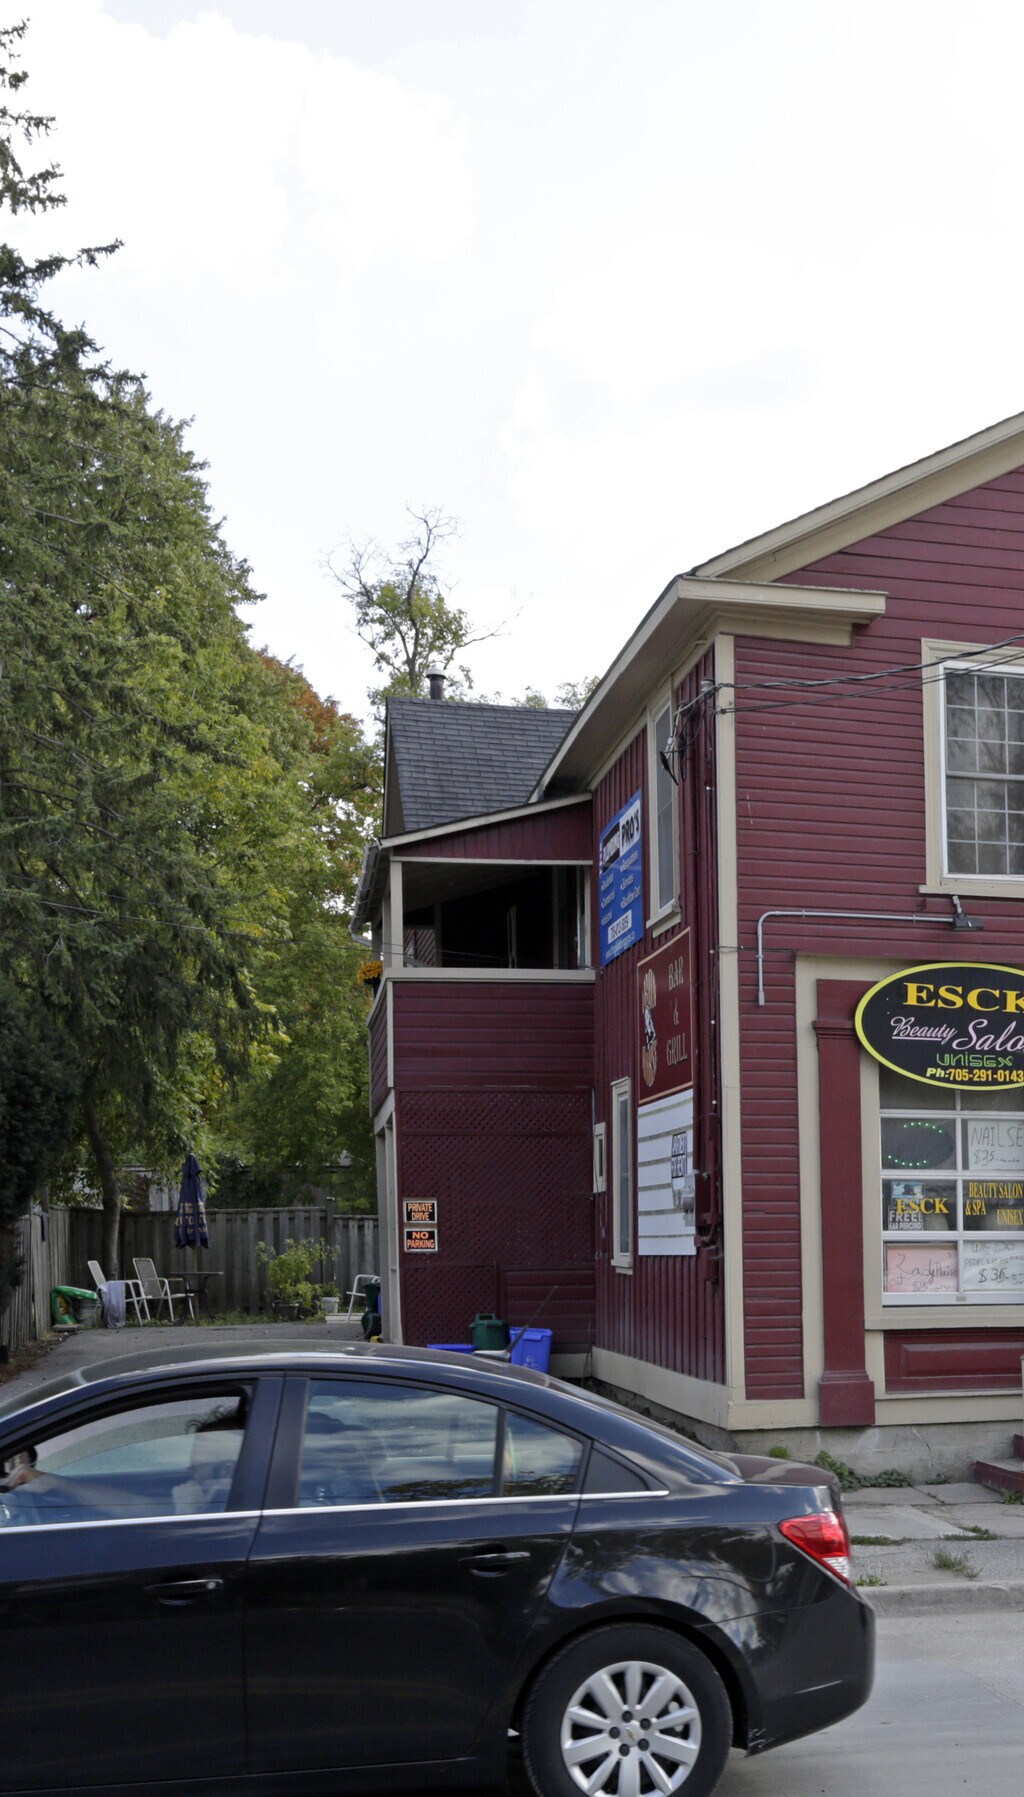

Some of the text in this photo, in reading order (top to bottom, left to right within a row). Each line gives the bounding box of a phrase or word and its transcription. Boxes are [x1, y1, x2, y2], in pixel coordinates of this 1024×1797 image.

[669, 956, 683, 991] BAR
[890, 1016, 958, 1045] Beauty
[666, 1032, 687, 1066] GRILL
[969, 1182, 1024, 1198] BEAUTY SALON
[407, 1203, 433, 1212] PRIVATE
[896, 1198, 949, 1214] ESCK
[965, 1200, 986, 1216] & SPA
[411, 1212, 430, 1221] DRIVE
[997, 1209, 1024, 1226] UNISEX
[412, 1231, 429, 1239] NO
[407, 1239, 435, 1249] PARKING
